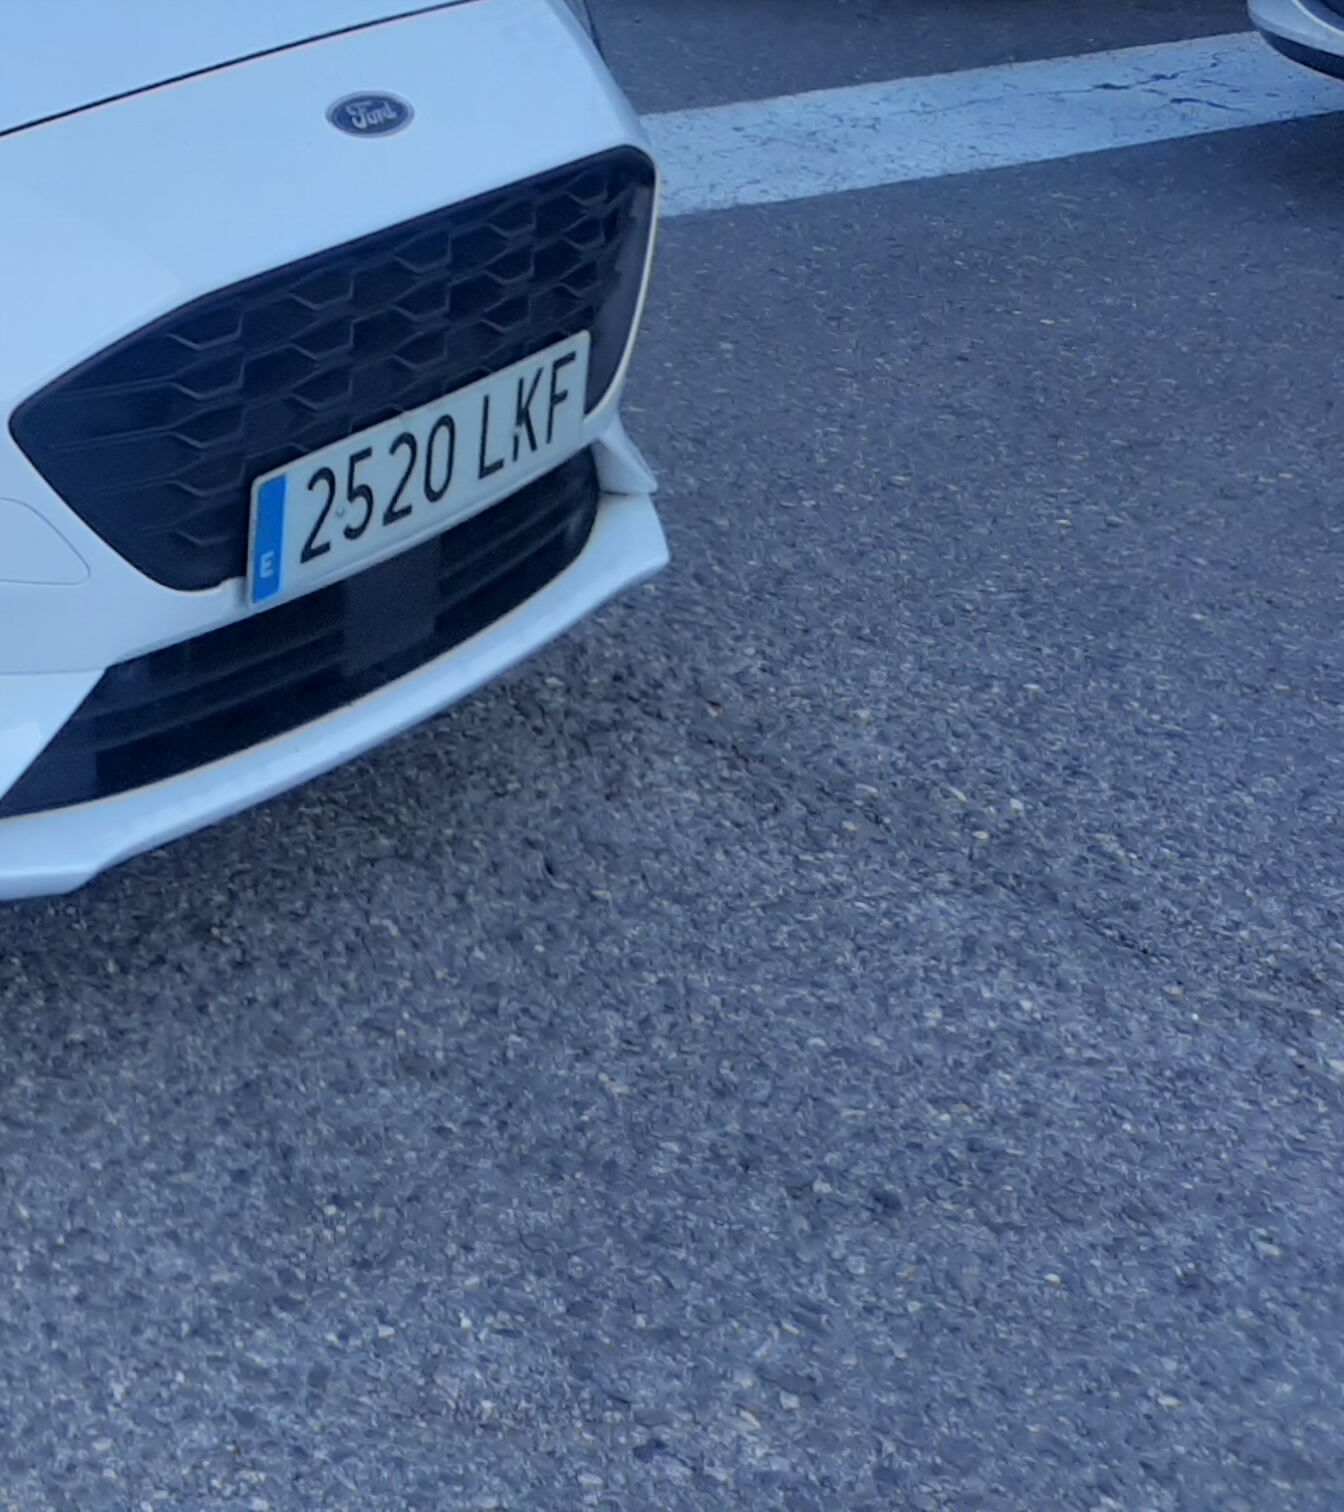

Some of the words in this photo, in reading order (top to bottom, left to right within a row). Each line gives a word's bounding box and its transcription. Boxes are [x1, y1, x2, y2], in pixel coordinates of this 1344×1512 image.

[346, 100, 398, 129] Ford
[300, 414, 456, 564] 2520
[478, 350, 577, 480] LKF
[260, 551, 275, 579] E
